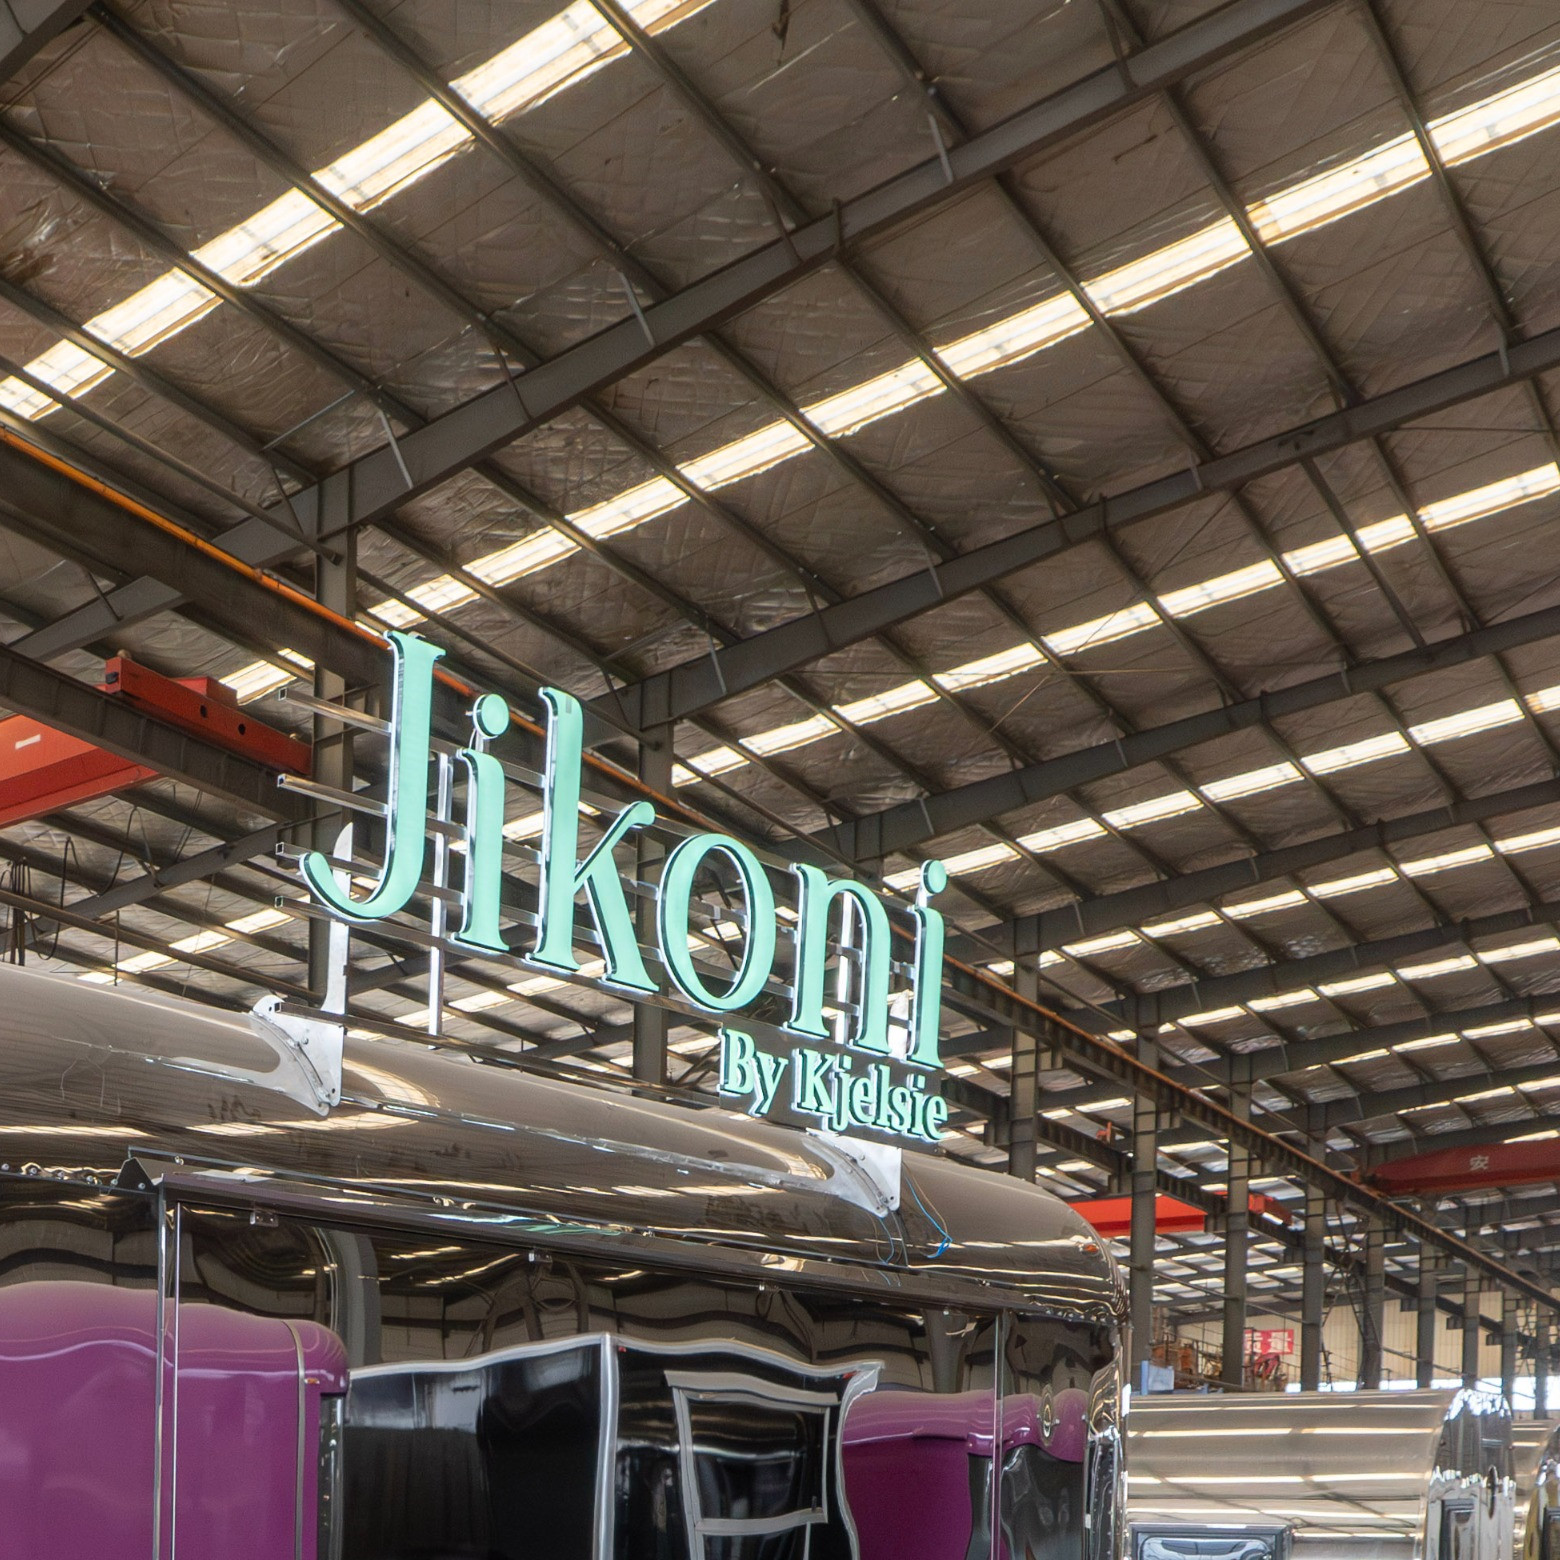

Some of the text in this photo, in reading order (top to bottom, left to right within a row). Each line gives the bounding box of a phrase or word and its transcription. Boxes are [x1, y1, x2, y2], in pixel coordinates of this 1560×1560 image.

[298, 630, 949, 1069] Jikoni
[717, 1027, 949, 1142] By Kjelsie
[1469, 1155, 1490, 1171] 安
